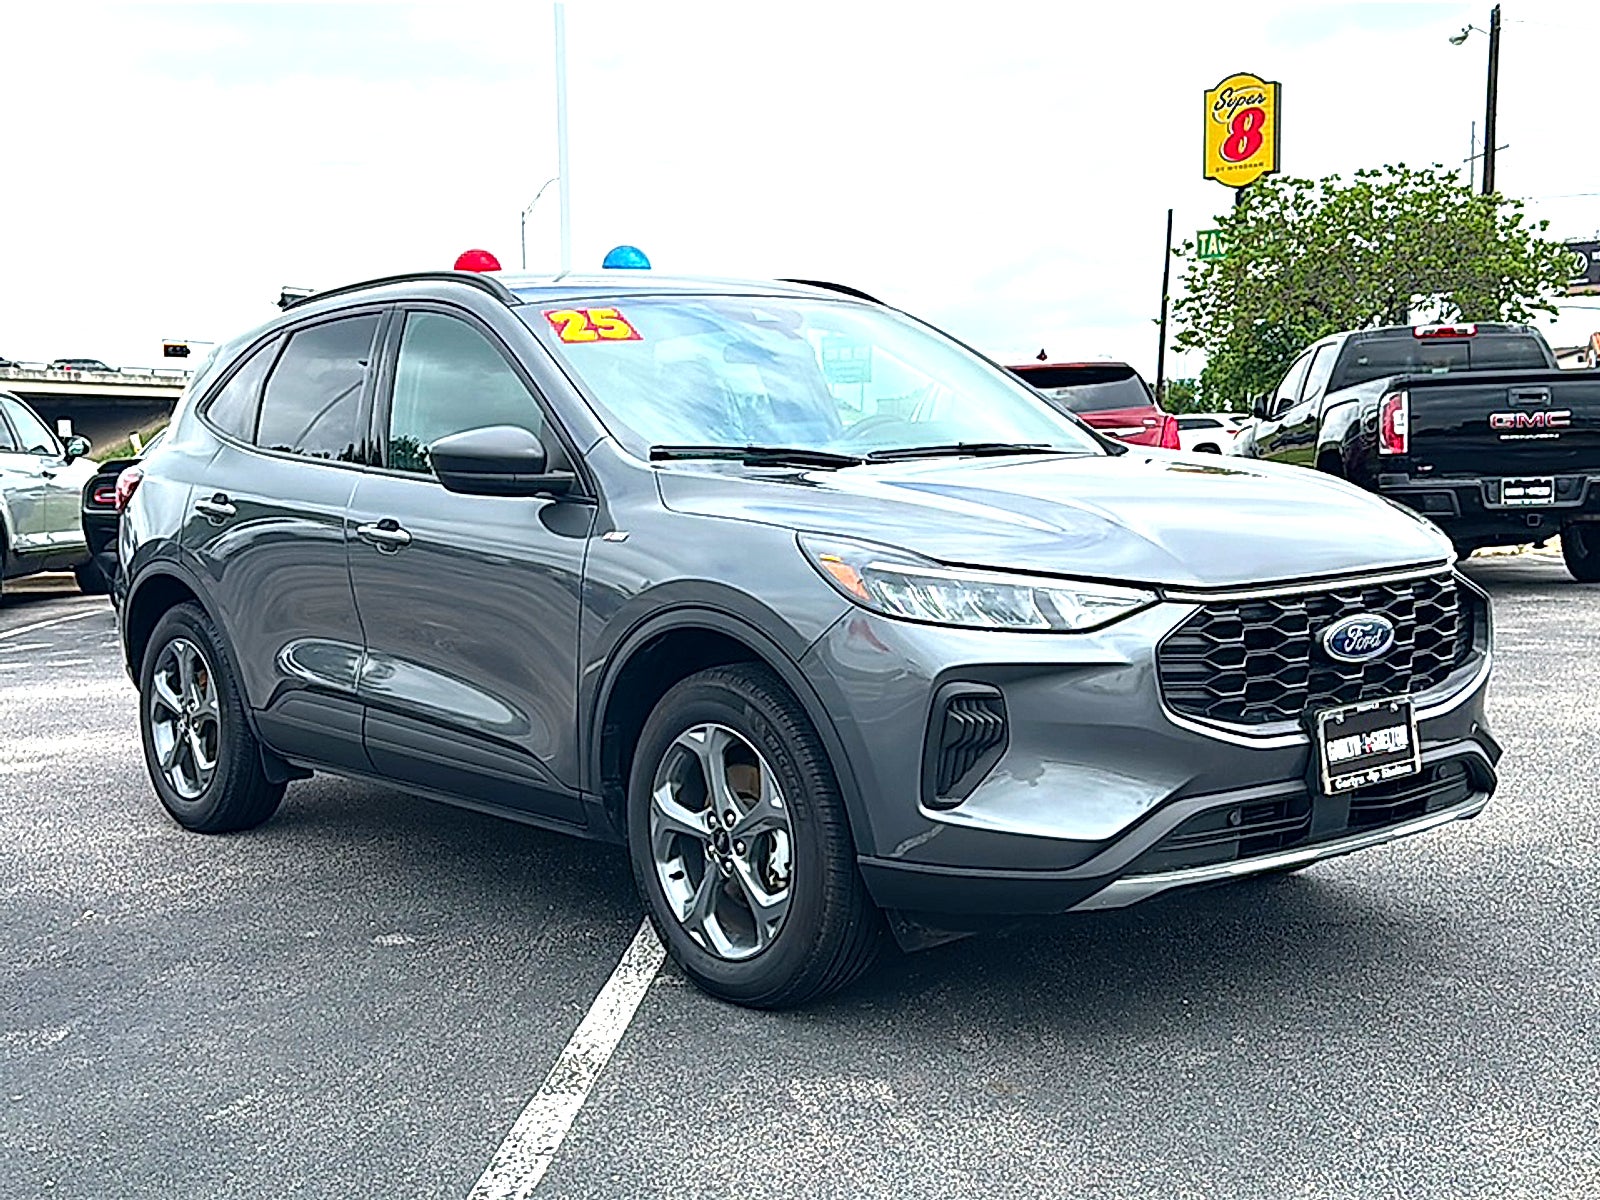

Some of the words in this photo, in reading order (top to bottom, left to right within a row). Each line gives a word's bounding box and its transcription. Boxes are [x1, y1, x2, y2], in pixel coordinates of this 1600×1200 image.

[1214, 87, 1267, 119] Super
[1221, 106, 1266, 162] 8
[548, 308, 632, 341] 25
[1490, 410, 1571, 428] GMC
[1344, 624, 1383, 652] Ford
